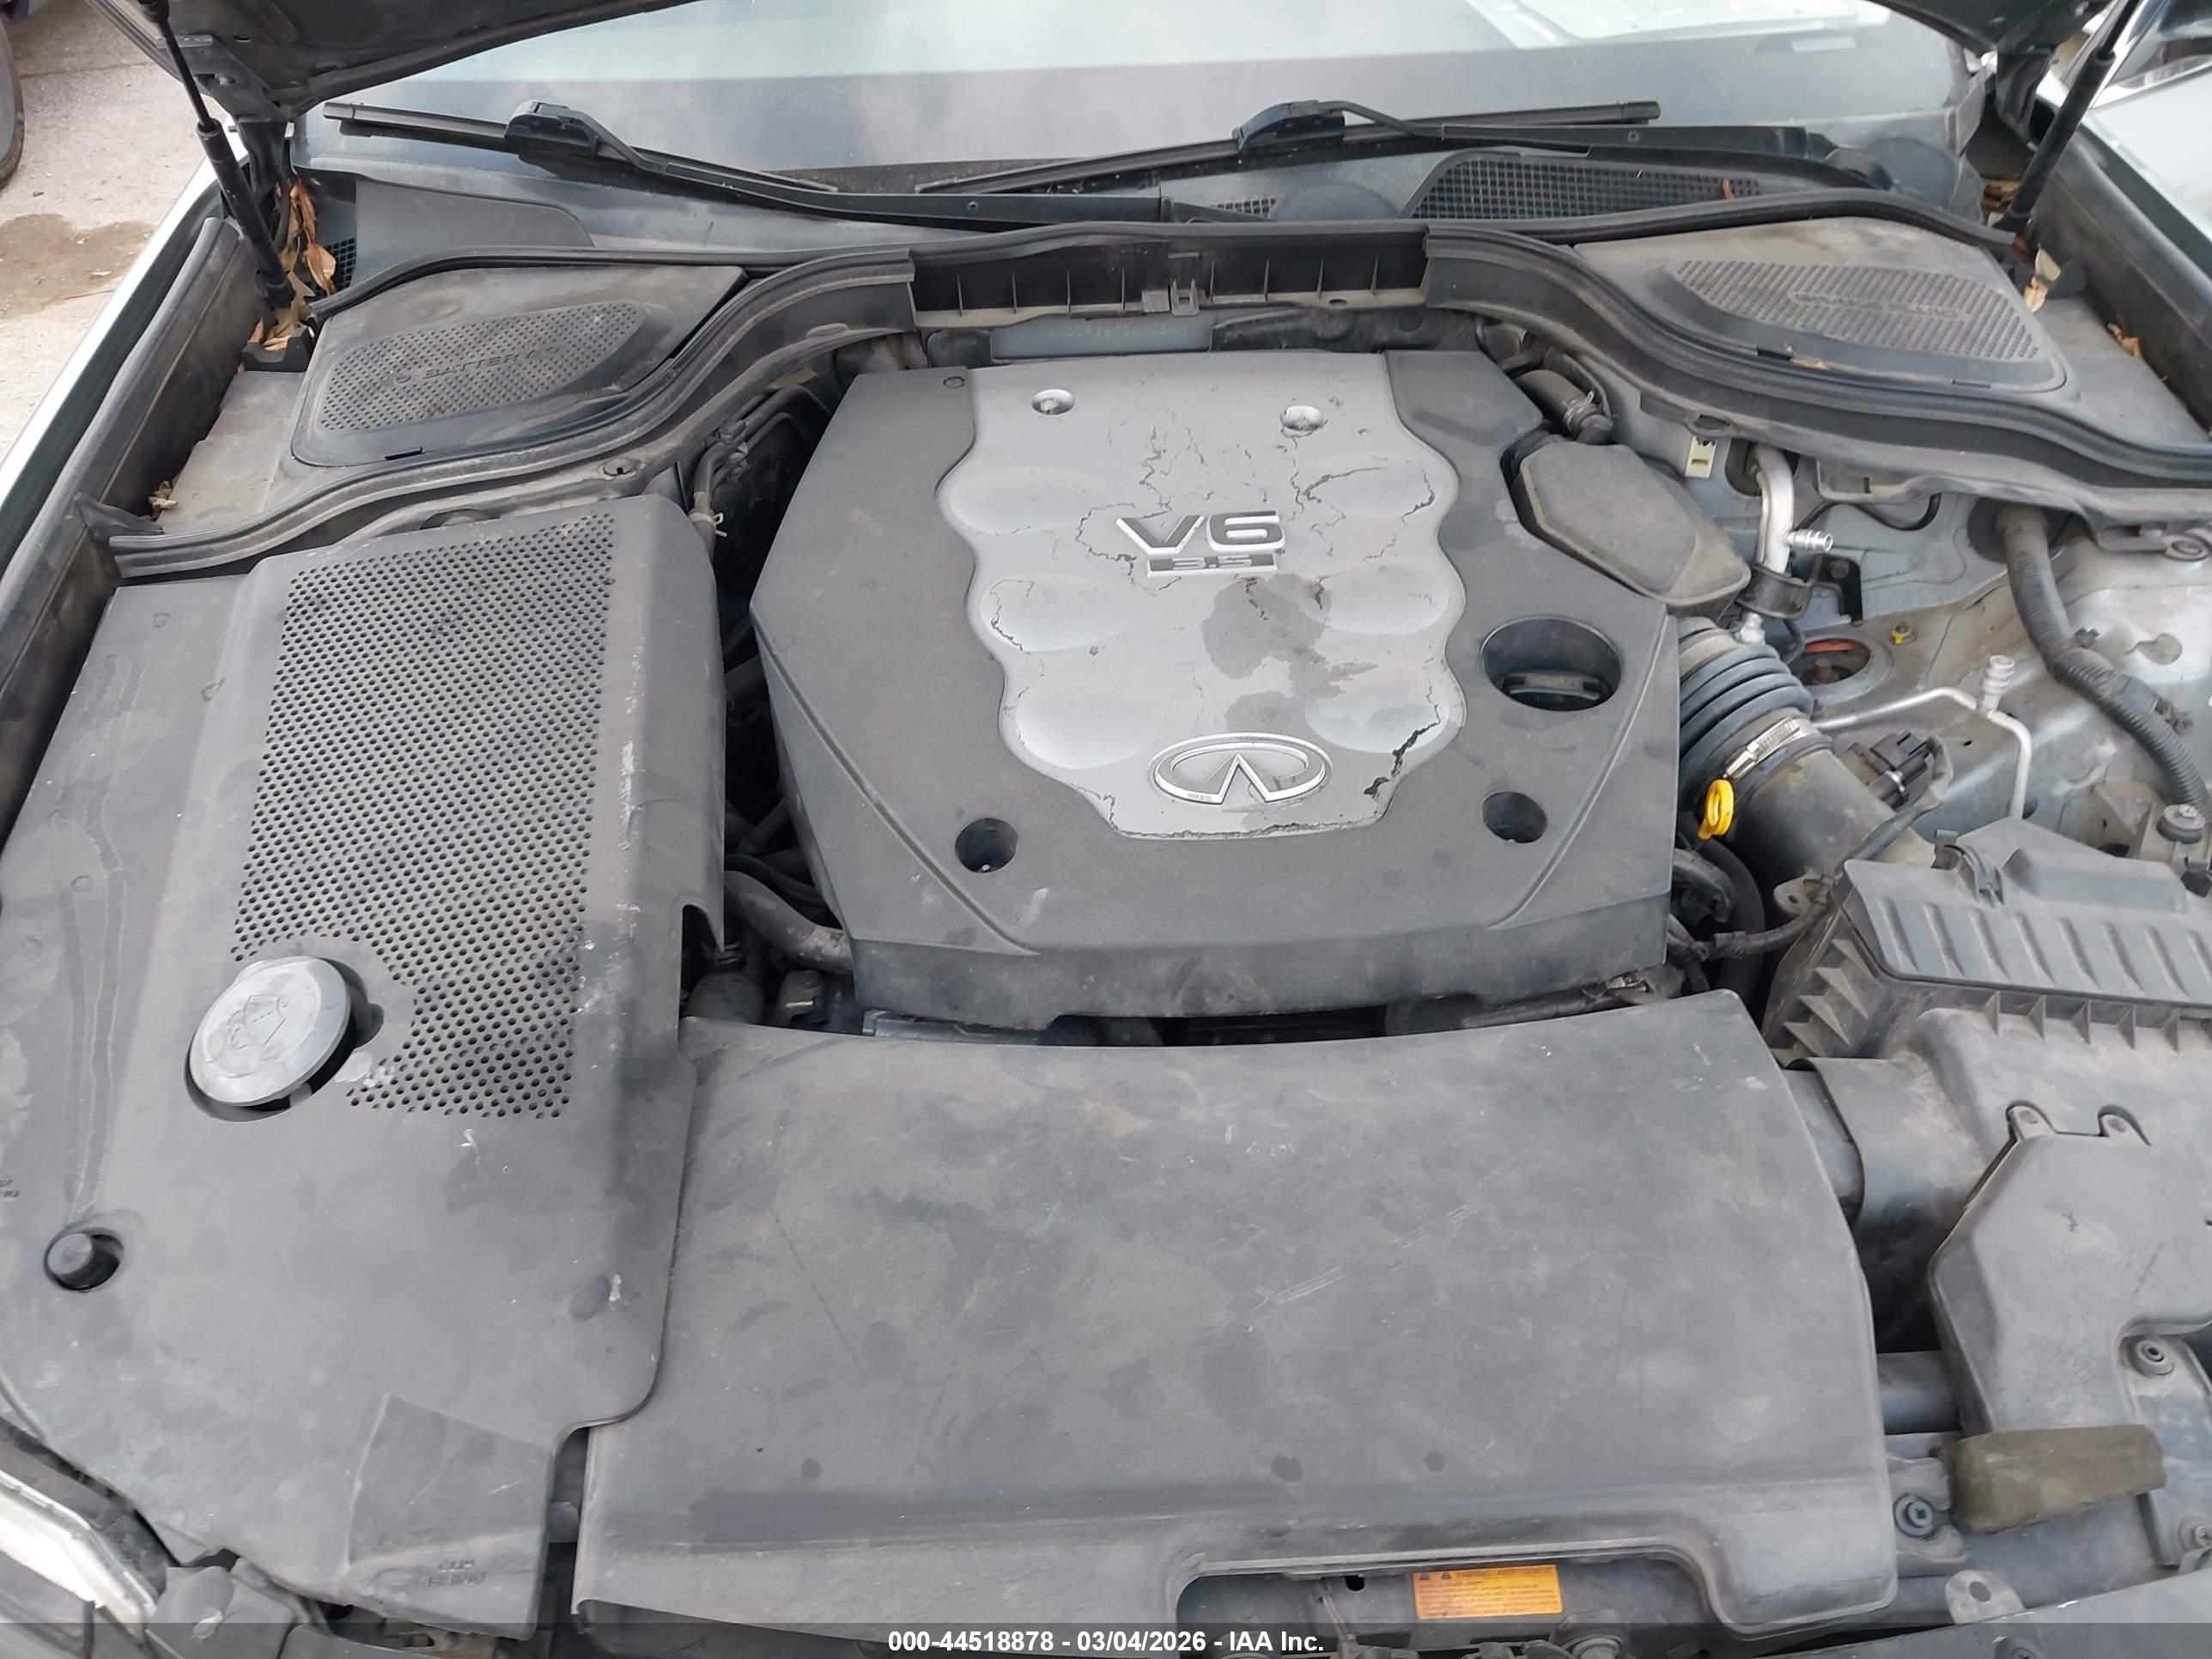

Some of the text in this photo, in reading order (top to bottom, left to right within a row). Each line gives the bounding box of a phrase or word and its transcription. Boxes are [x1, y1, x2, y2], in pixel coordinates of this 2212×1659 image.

[422, 349, 536, 380] BATTERY
[1115, 511, 1286, 556] V6
[1170, 555, 1253, 571] 3.5
